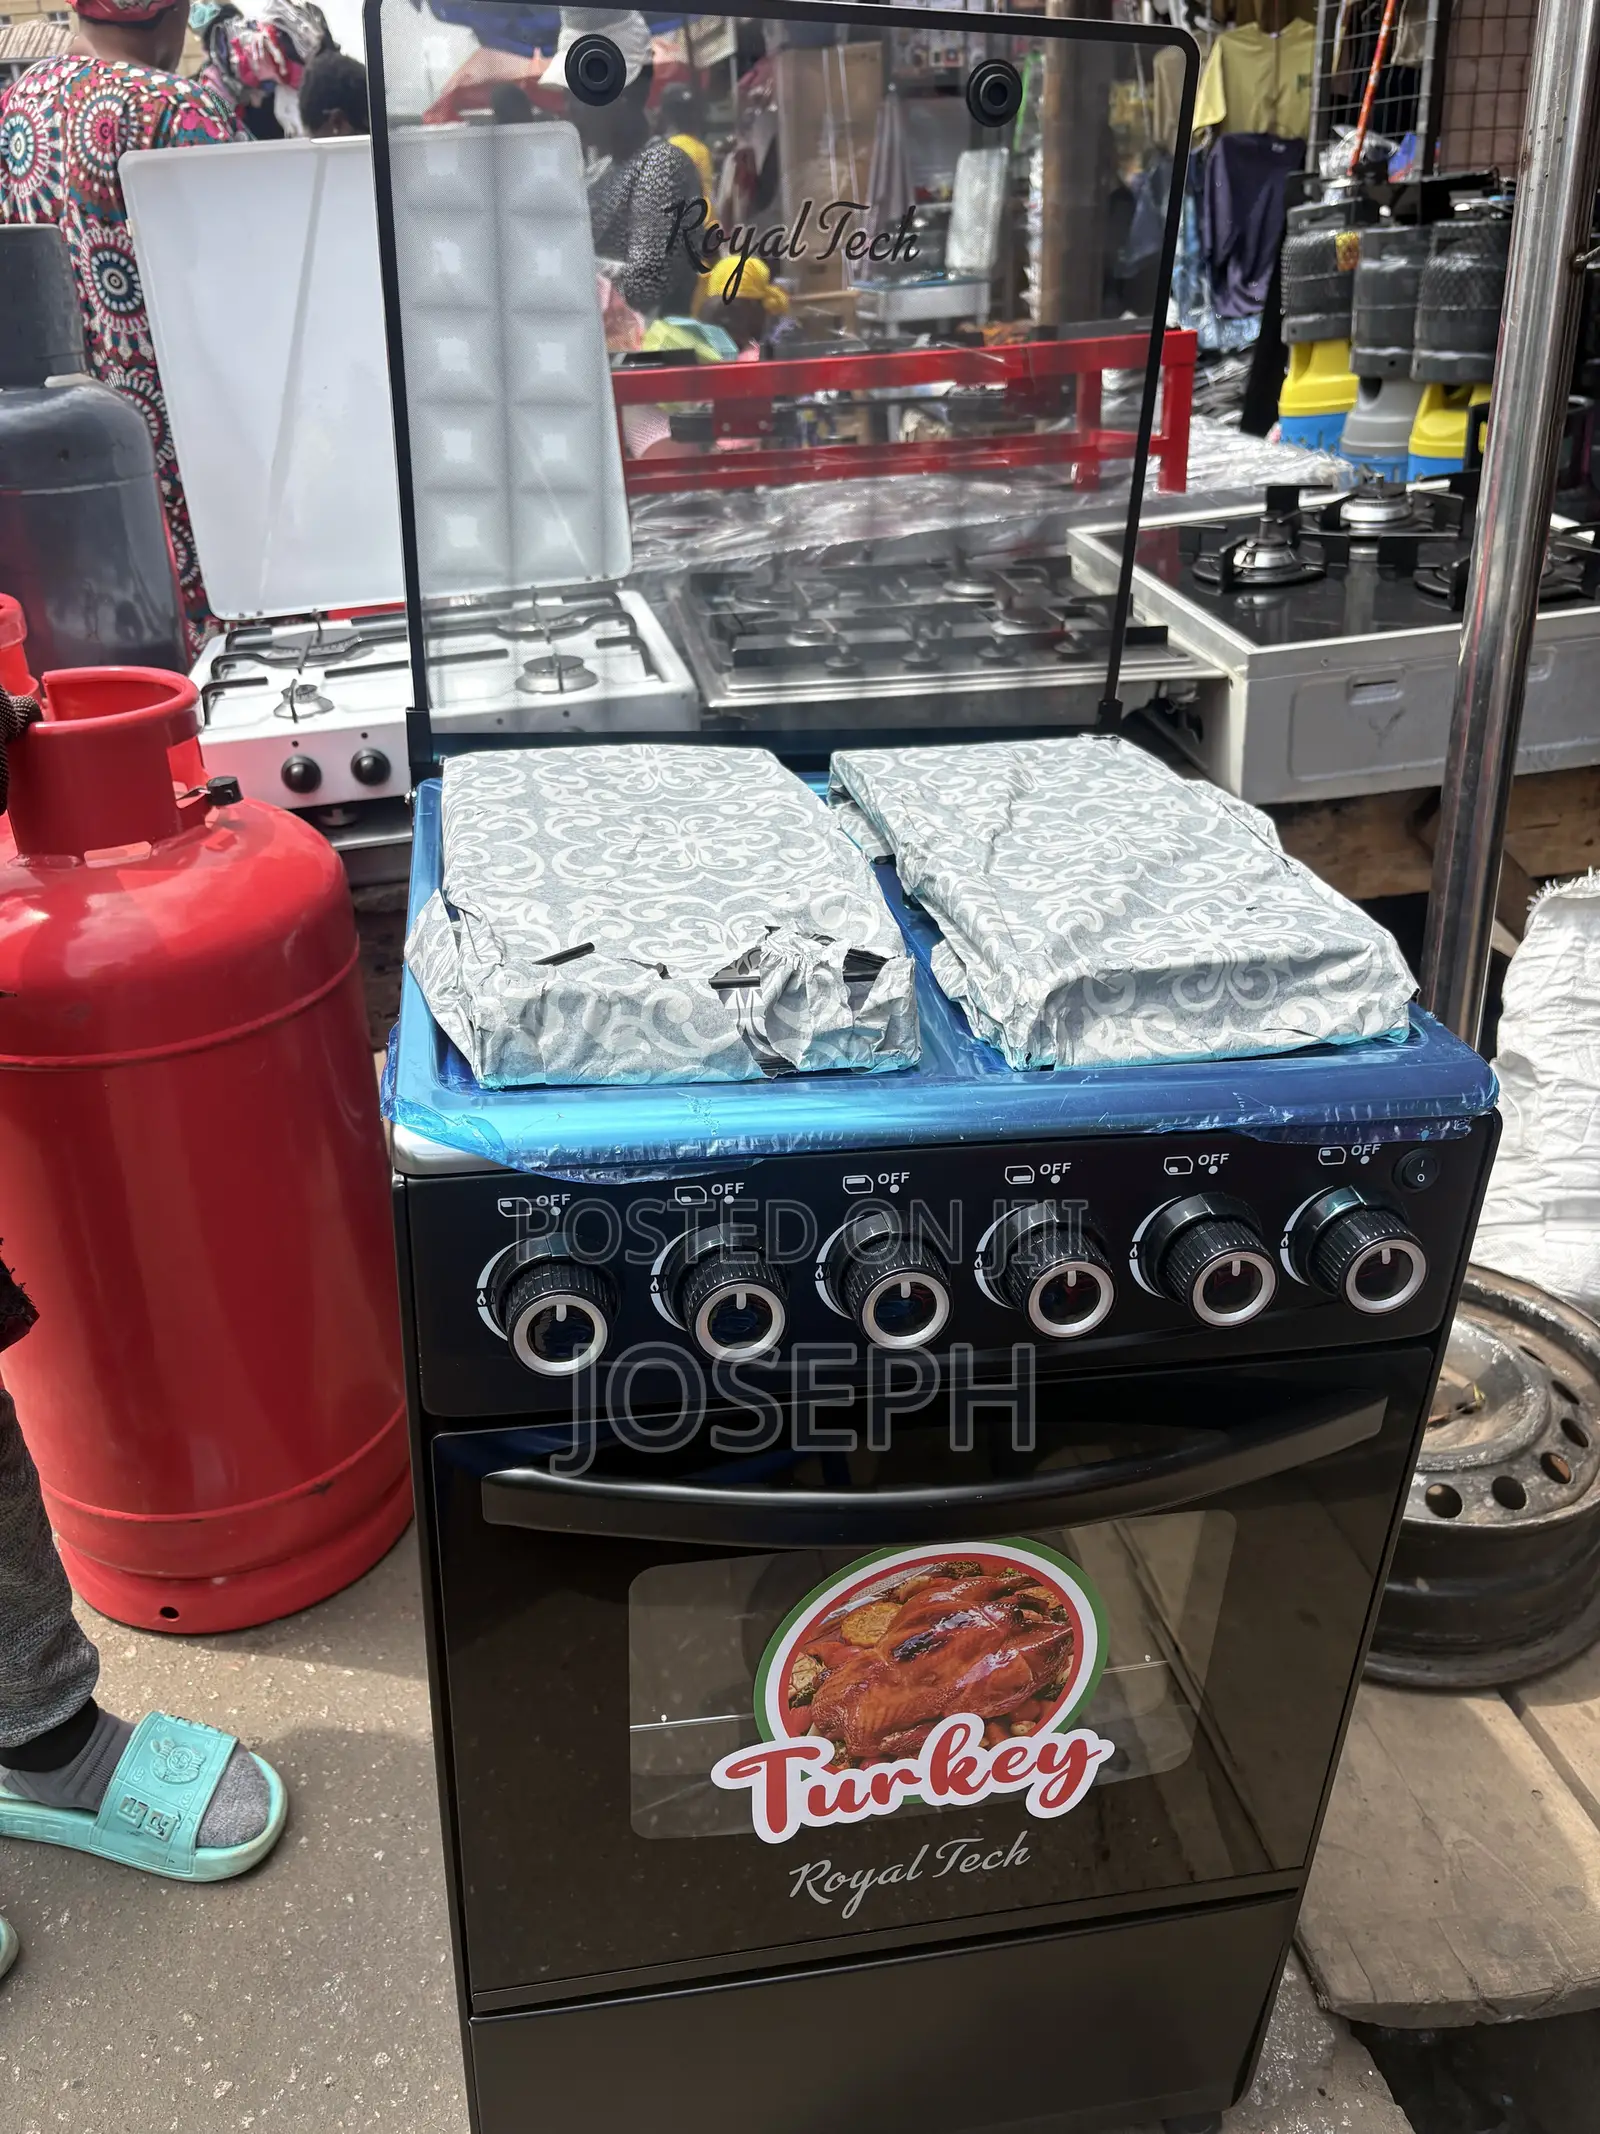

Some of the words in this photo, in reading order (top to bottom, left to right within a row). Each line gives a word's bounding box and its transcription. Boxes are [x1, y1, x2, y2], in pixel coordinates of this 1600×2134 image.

[664, 197, 812, 305] Royal
[816, 200, 920, 263] Tech
[1351, 1143, 1382, 1156] OFF
[1198, 1153, 1230, 1166] OFF
[1039, 1162, 1072, 1175] OFF
[877, 1172, 911, 1185] OFF
[711, 1182, 745, 1196] OFF
[536, 1193, 571, 1207] OFF
[724, 1721, 1103, 1835] Turkey
[788, 1843, 929, 1920] Royal
[932, 1830, 1031, 1879] Tech
